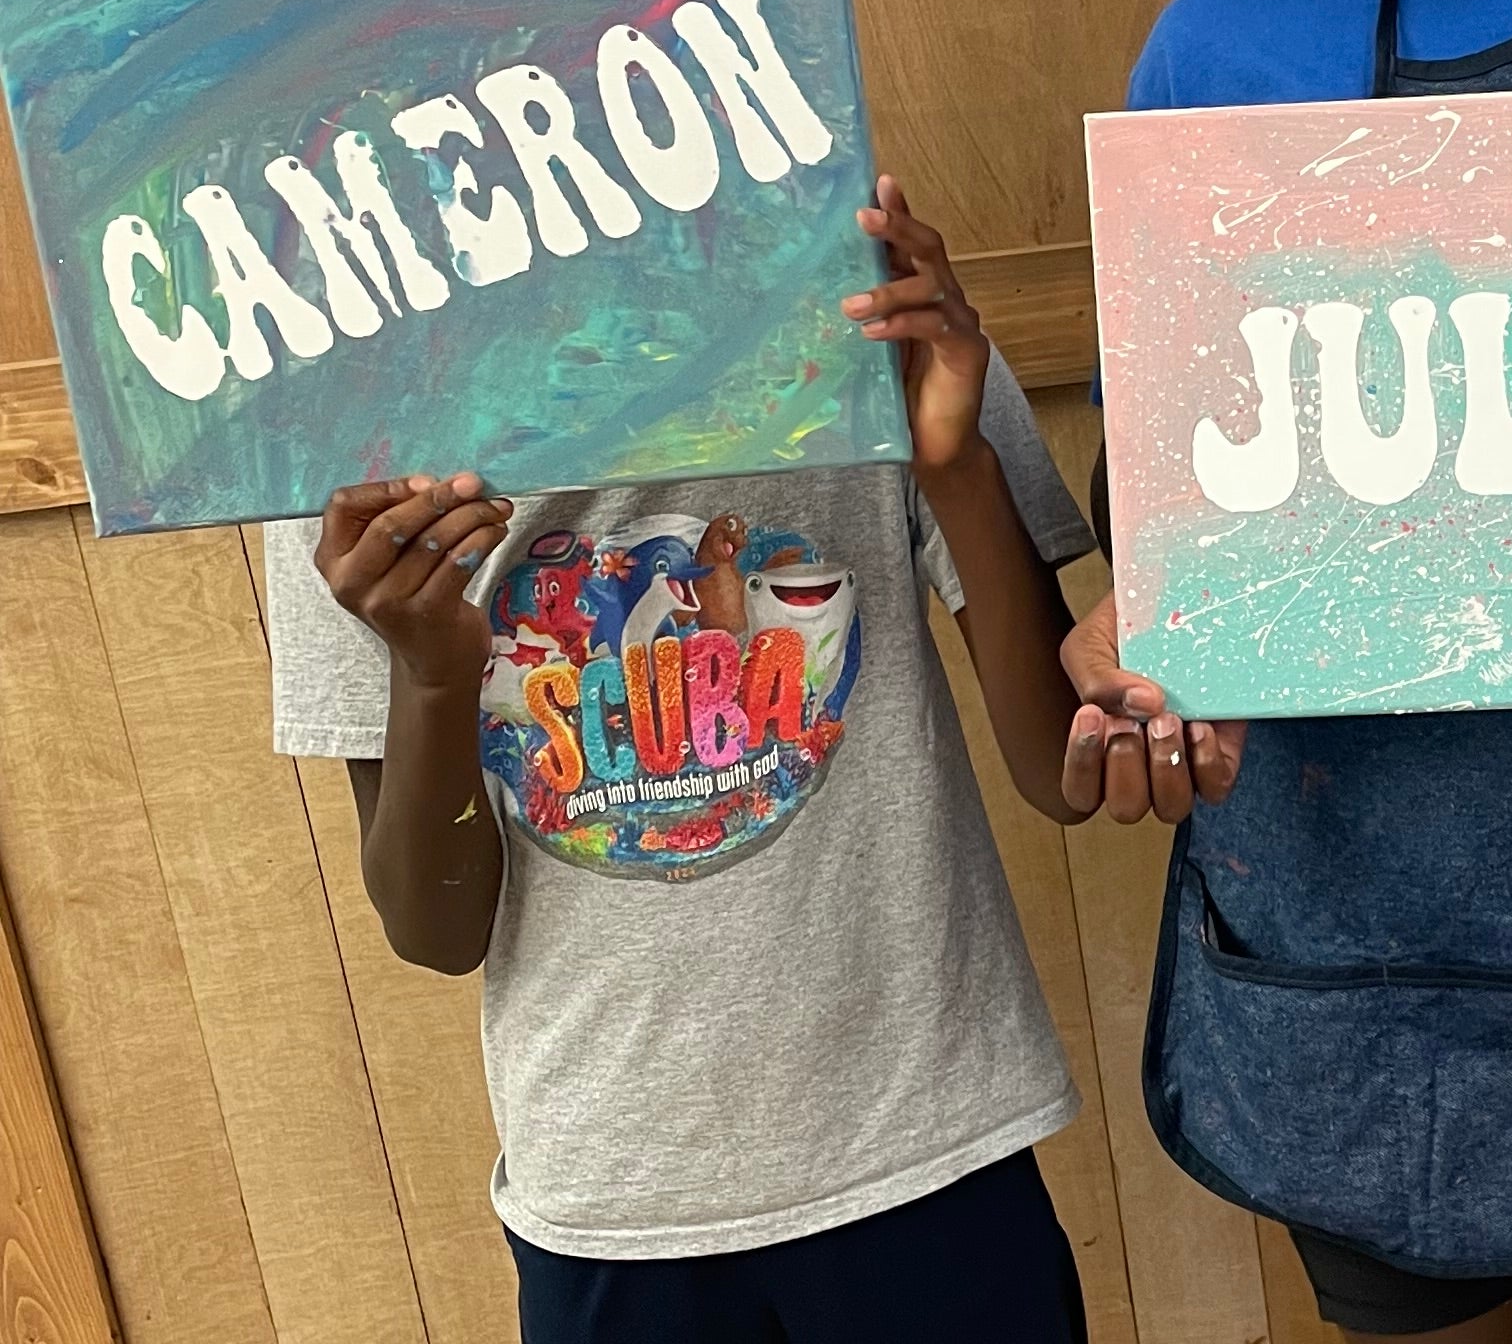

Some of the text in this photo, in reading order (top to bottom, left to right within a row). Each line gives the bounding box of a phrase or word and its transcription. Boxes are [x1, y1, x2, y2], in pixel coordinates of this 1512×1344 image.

[523, 627, 805, 794] SCUBA
[567, 789, 606, 820] diving
[606, 779, 636, 805] into
[638, 772, 713, 800] friendship
[716, 762, 750, 793] with
